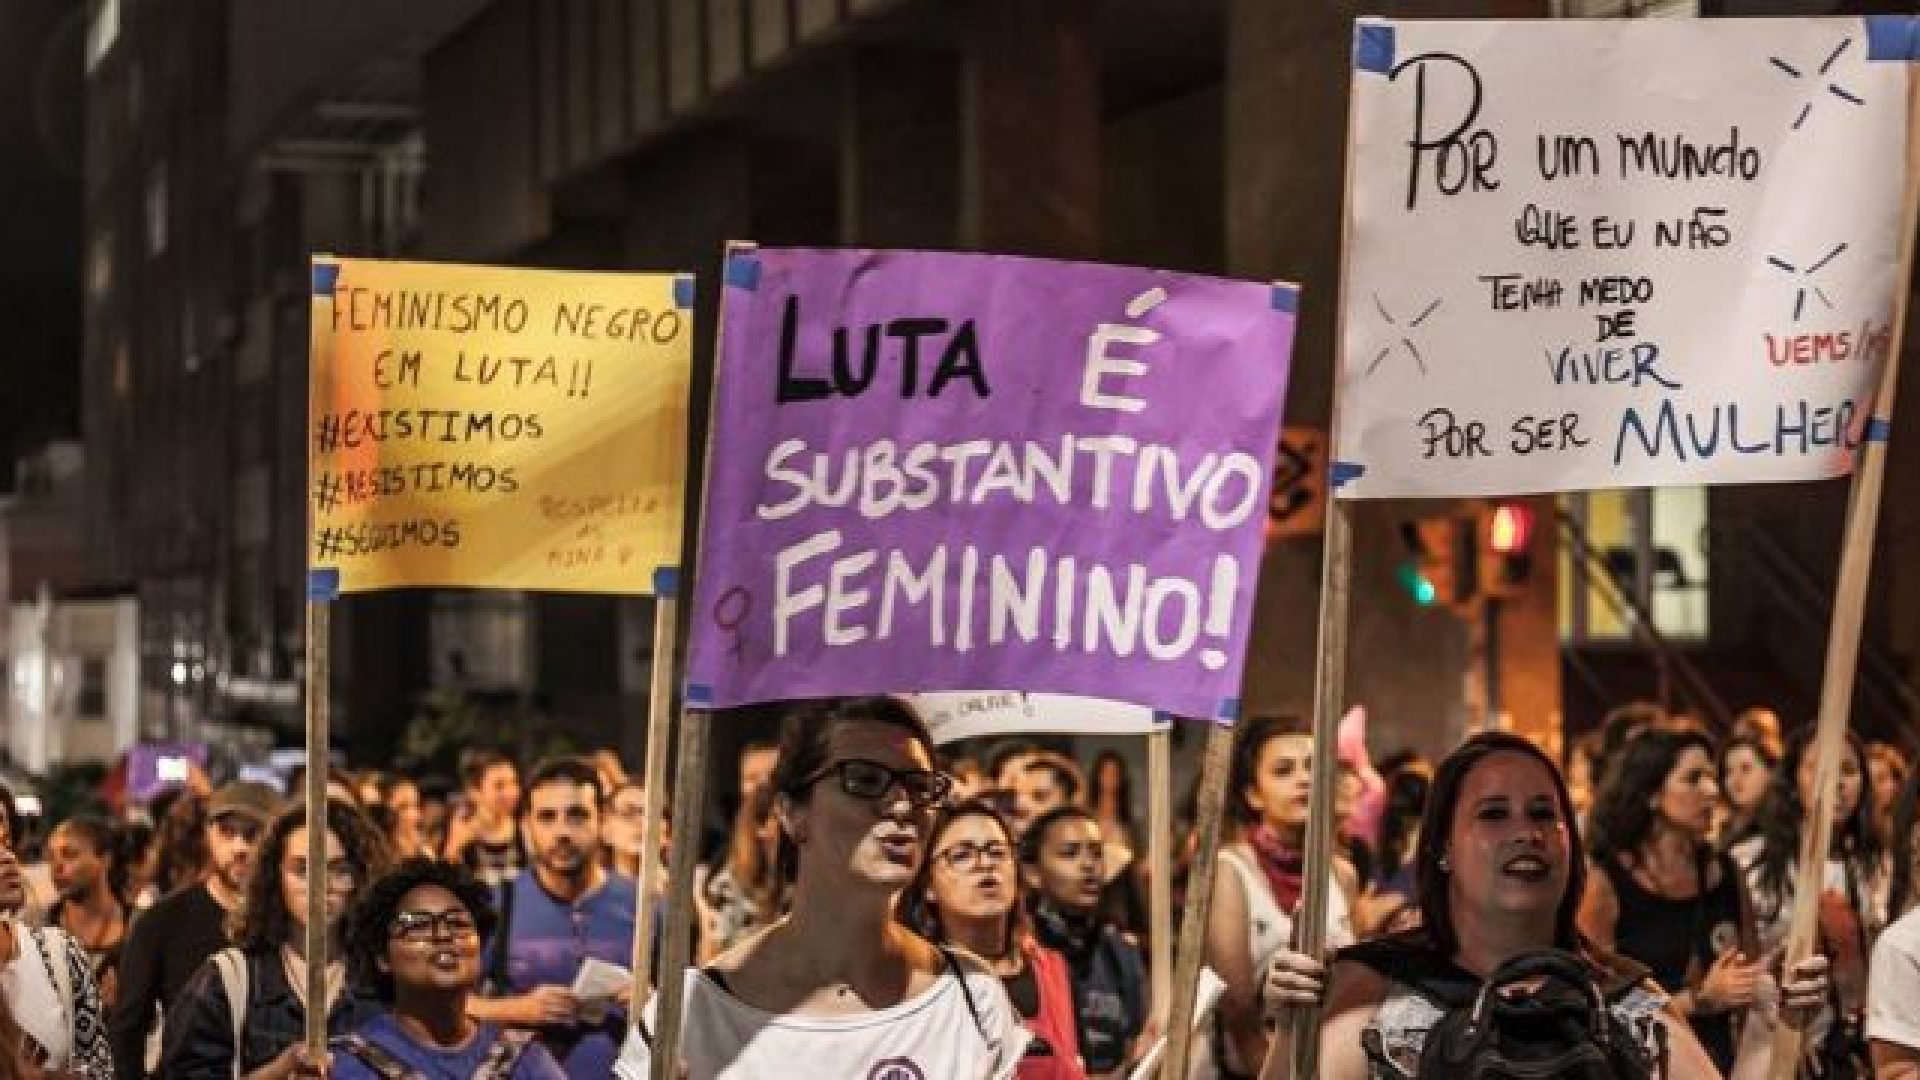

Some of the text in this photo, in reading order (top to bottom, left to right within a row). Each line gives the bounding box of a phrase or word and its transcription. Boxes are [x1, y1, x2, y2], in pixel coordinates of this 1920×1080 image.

[1514, 203, 1731, 250] QUE EU NÃO
[332, 286, 681, 343] FEMINISMO NEGRO
[1578, 277, 1654, 304] MEDO
[775, 287, 1168, 413] LUTA É
[1596, 311, 1635, 342] DE
[374, 350, 593, 398] EM LUTA!!
[1545, 342, 1683, 390] VIVER
[315, 409, 544, 453] #EXISTIMOS
[1511, 411, 1591, 454] SER
[1613, 397, 1858, 466] MULHER
[313, 462, 519, 514] #RESISTIMOS
[757, 433, 1263, 530] SUBSTANTIVO
[771, 529, 1240, 669] FEMININO!
